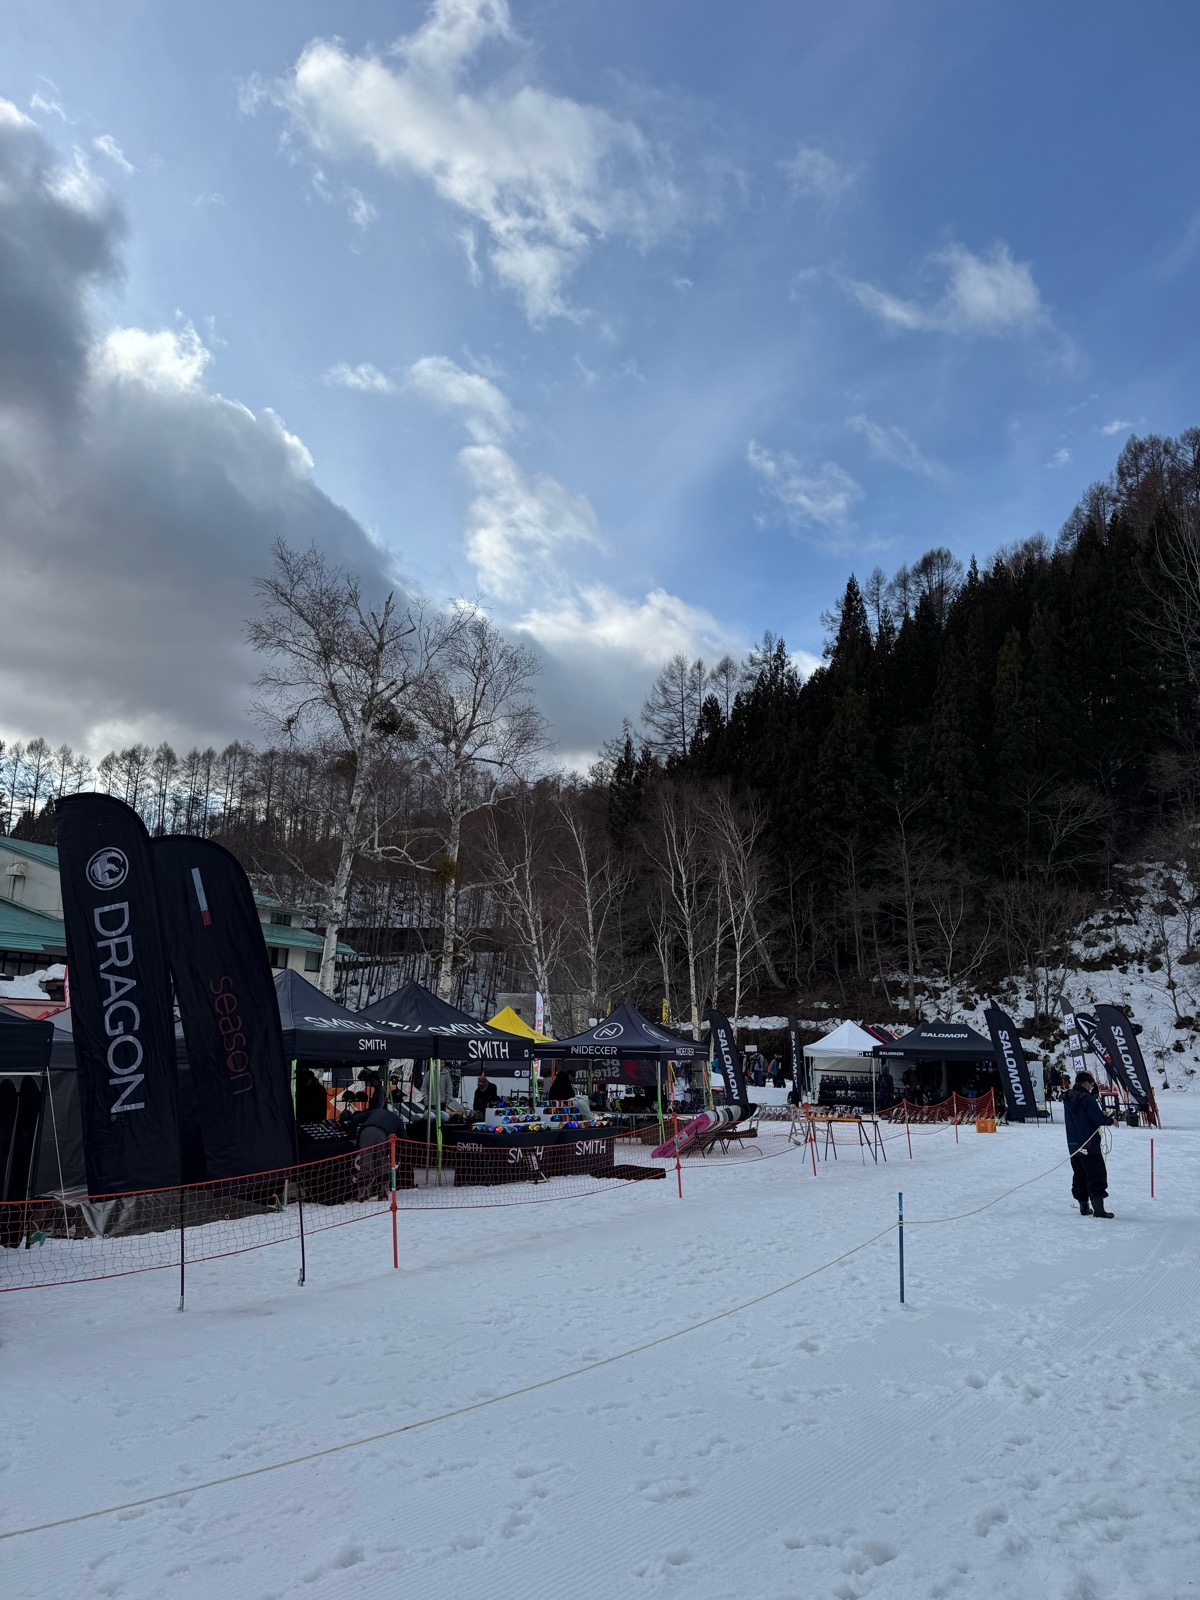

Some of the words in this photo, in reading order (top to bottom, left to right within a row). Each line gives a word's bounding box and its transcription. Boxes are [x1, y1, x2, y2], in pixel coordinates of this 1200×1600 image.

[93, 901, 145, 1114] DRAGON
[303, 1016, 384, 1032] SMITH
[428, 1022, 493, 1037] SMITH
[209, 975, 255, 1095] season
[920, 1031, 968, 1039] SALOMON
[358, 1038, 387, 1051] SMITH
[468, 1039, 509, 1059] SMITH
[570, 1045, 618, 1056] NIDECKER
[717, 1028, 740, 1100] SALOMON
[997, 1029, 1026, 1106] SALOMON
[456, 1141, 483, 1153] SMITH
[575, 1139, 607, 1156] SMITH
